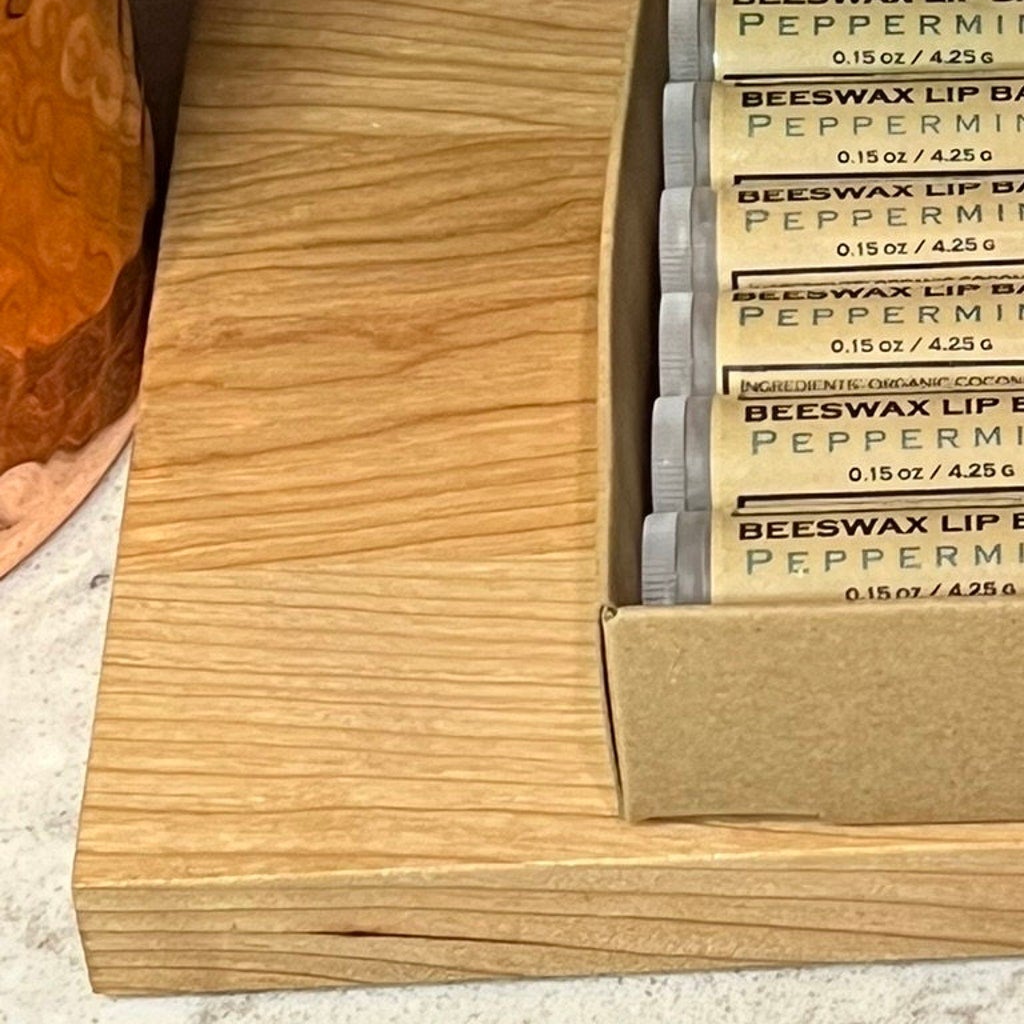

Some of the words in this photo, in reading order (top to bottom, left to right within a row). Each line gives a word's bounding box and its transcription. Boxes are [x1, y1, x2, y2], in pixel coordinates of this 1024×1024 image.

[832, 50, 876, 65] 0.15
[910, 50, 923, 65] /
[929, 50, 977, 64] 4.25
[741, 87, 914, 108] BEESWAX
[925, 86, 980, 103] LIP
[837, 150, 879, 164] 0.15
[912, 149, 925, 164] /
[930, 148, 975, 163] 4.25
[737, 184, 914, 204] BEESWAX
[925, 182, 981, 198] LIP
[836, 242, 879, 257] 0.15
[913, 240, 926, 254] /
[932, 238, 978, 253] 4.25
[732, 286, 911, 302] BEESWAX
[924, 283, 981, 297] LIP
[831, 339, 873, 353] 0.15
[909, 337, 922, 352] /
[928, 336, 975, 351] 4.25
[744, 399, 931, 423] BEESWAX
[942, 397, 999, 416] LIP
[848, 467, 892, 483] 0.15
[929, 465, 942, 480] /
[948, 463, 996, 479] 4.25
[739, 516, 929, 541] BEESWAX
[941, 513, 1000, 533] LIP
